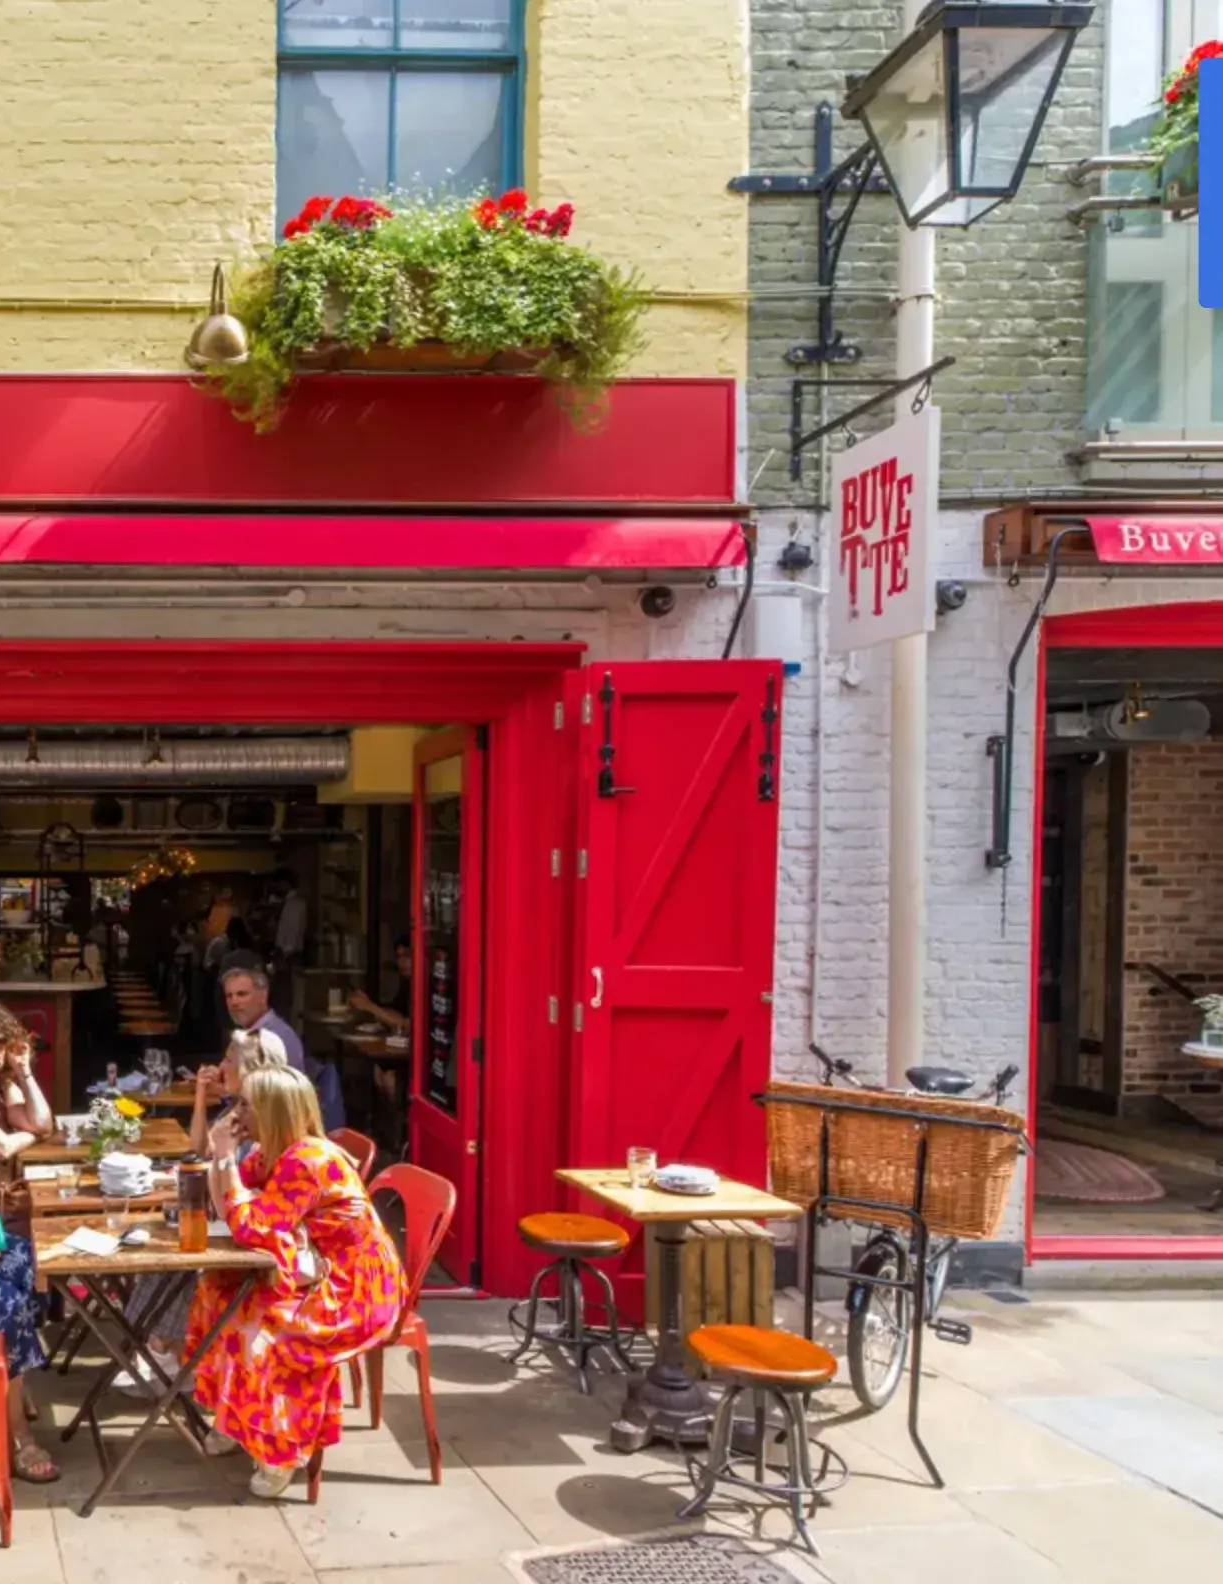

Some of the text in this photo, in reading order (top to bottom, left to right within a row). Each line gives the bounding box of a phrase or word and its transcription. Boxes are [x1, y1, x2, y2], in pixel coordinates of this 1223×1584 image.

[841, 456, 914, 538] BUVE
[839, 532, 910, 618] TTE
[1119, 525, 1223, 552] Buve
